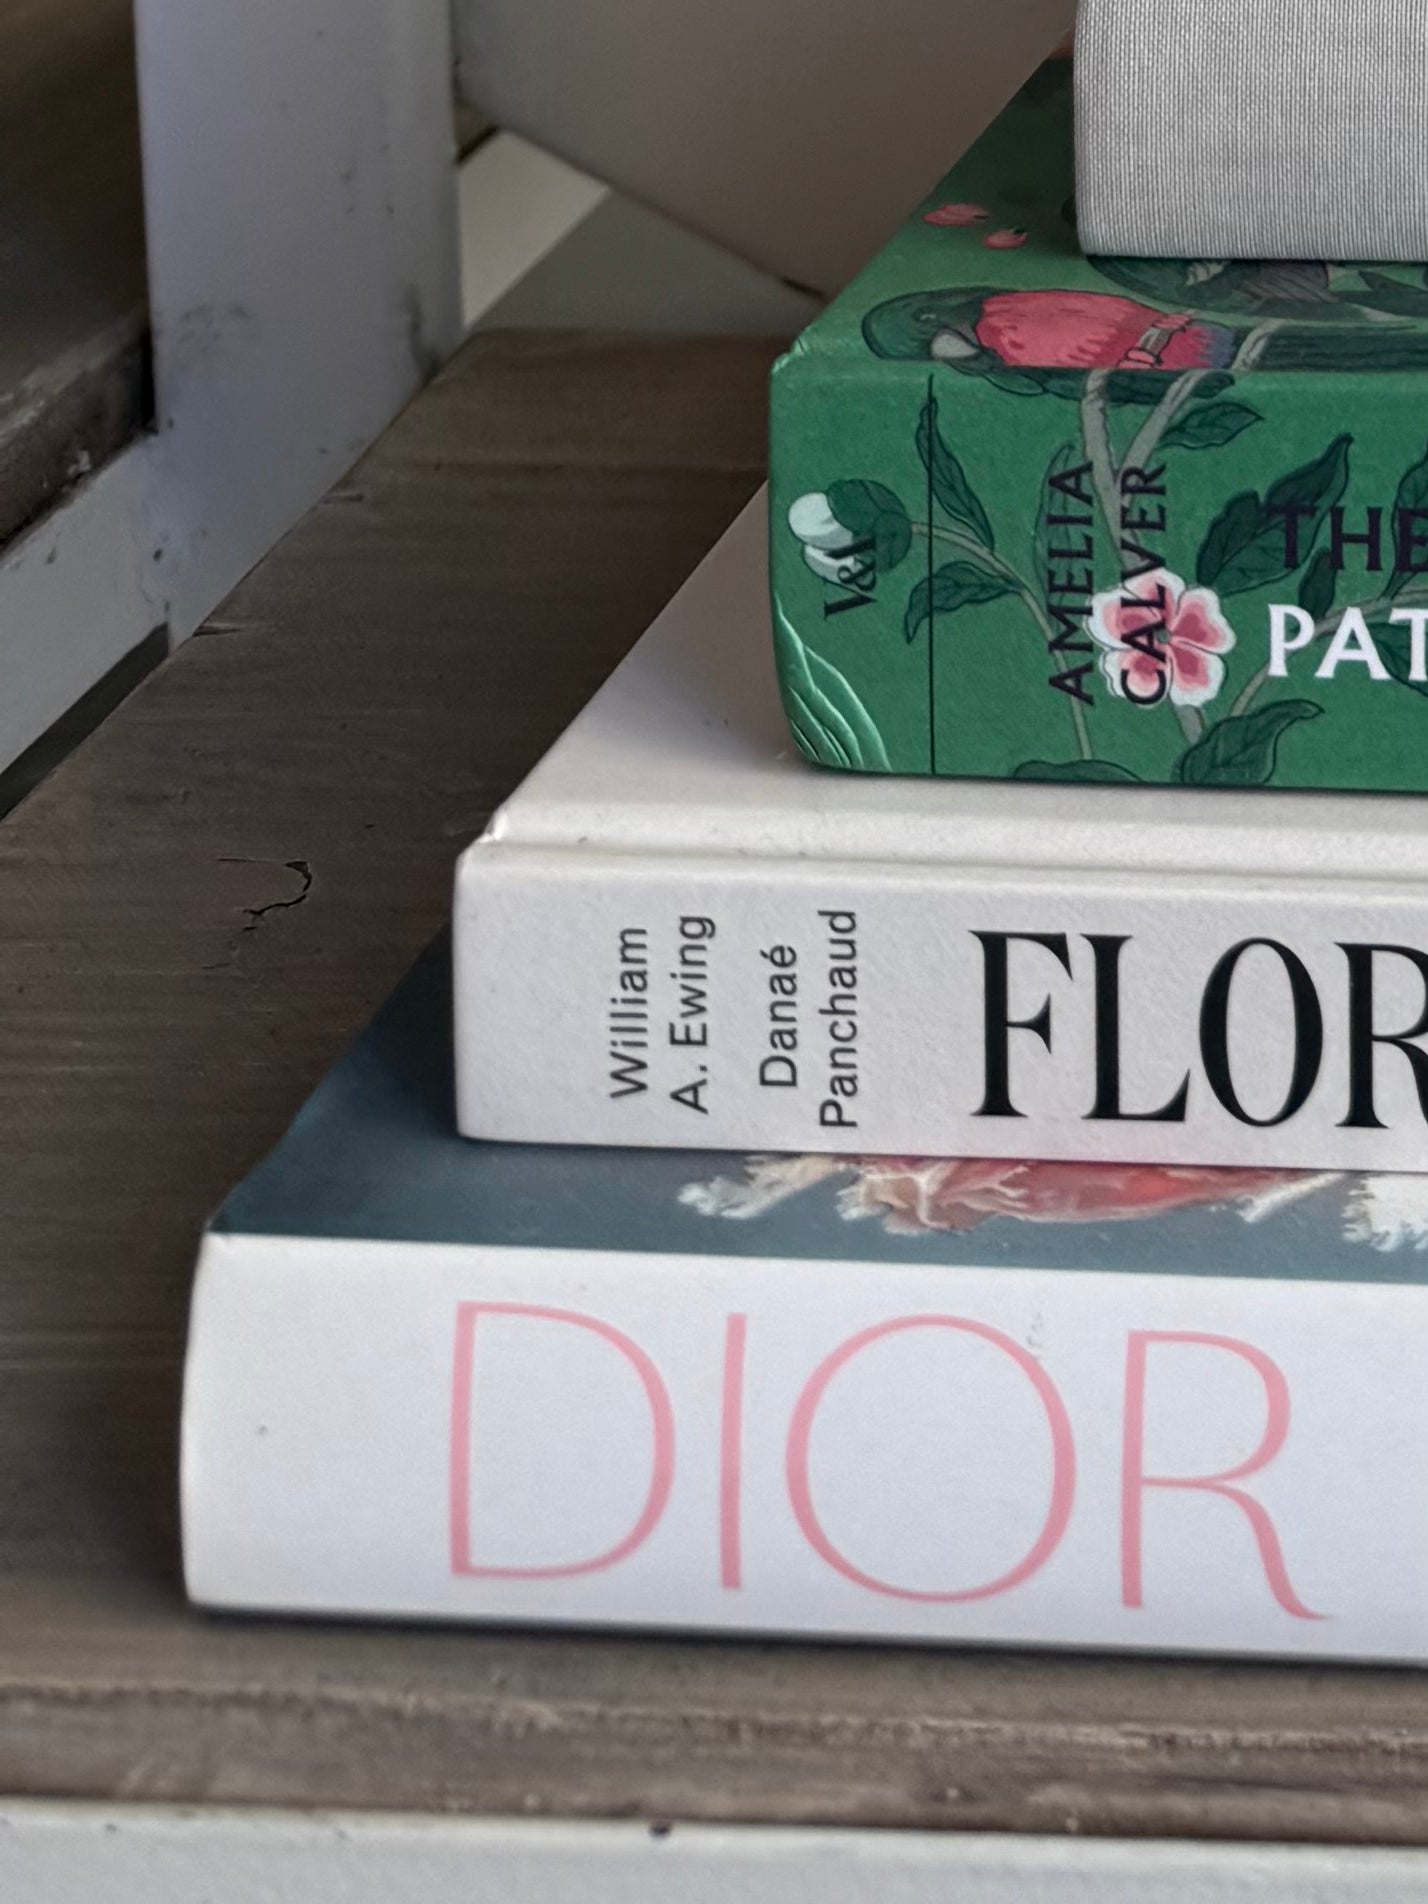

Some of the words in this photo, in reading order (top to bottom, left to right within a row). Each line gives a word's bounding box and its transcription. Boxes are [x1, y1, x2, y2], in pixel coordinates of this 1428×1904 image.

[1047, 461, 1096, 707] AMELIA
[1119, 463, 1169, 706] CALVER
[608, 925, 649, 1099] William
[669, 912, 717, 1049] Ewing
[758, 942, 799, 1089] Danaé
[819, 908, 859, 1129] Panchaud
[668, 1062, 710, 1115] A.
[444, 1296, 1334, 1625] DIOR
